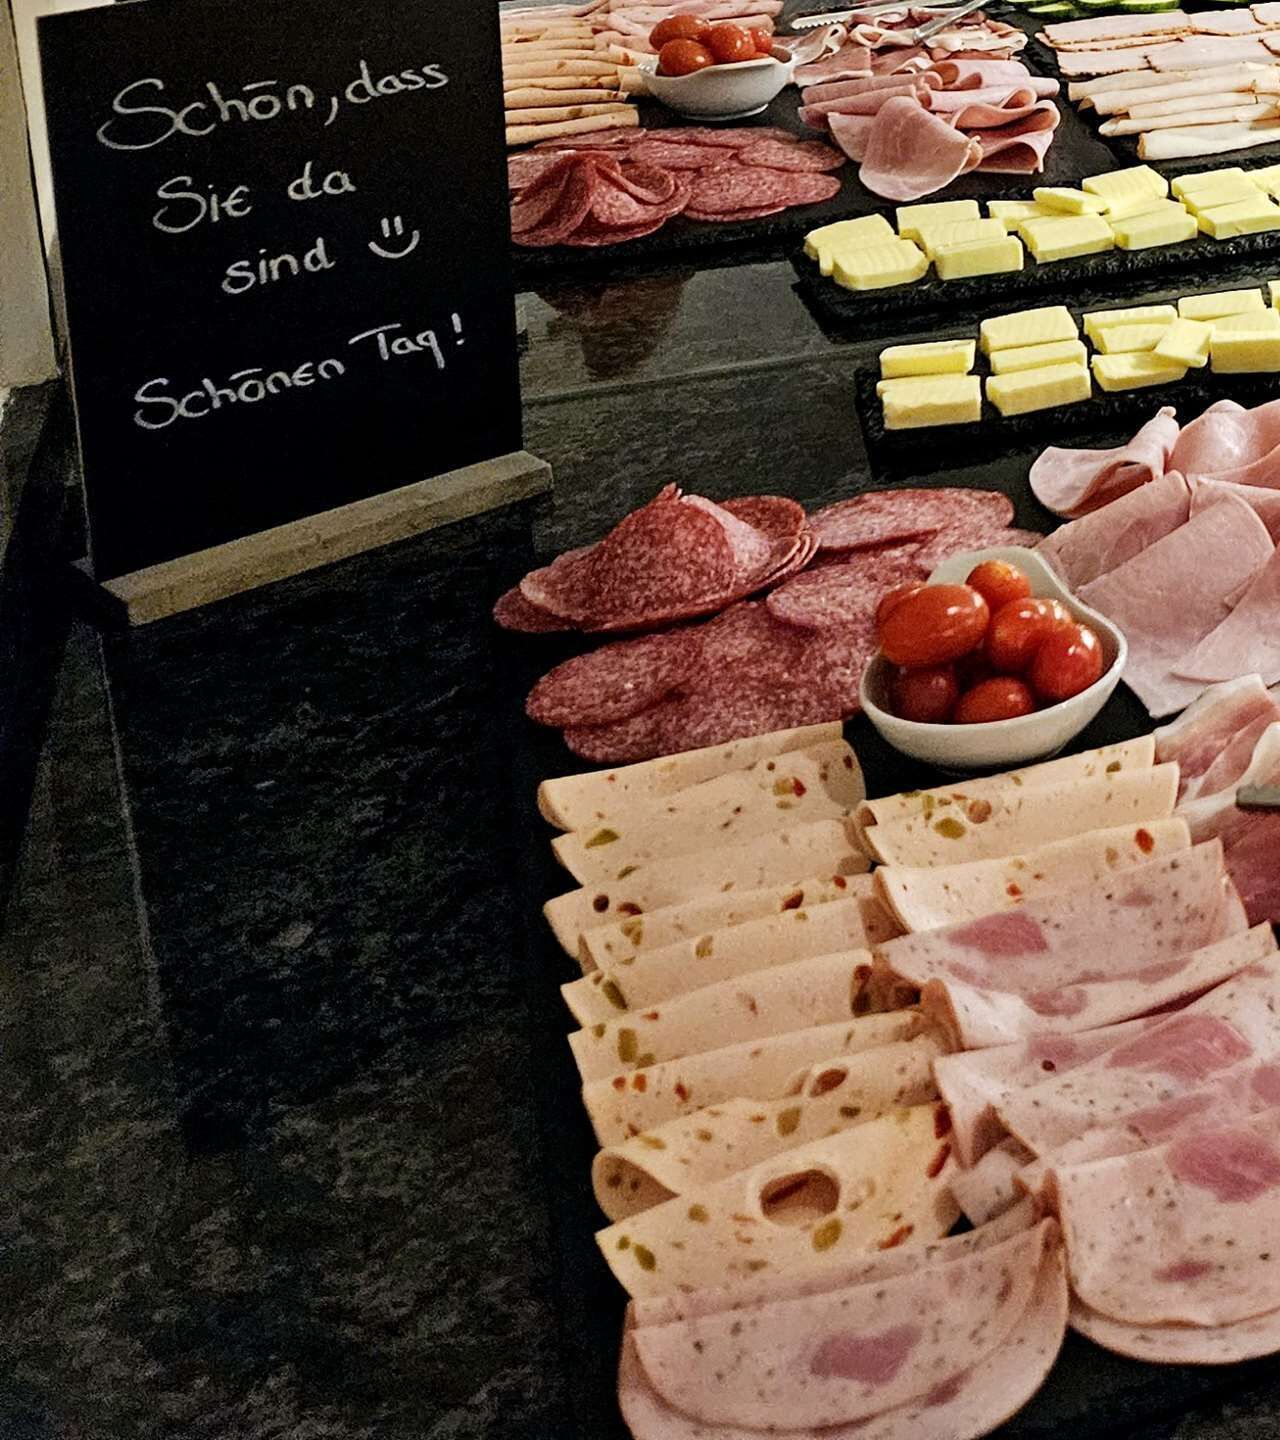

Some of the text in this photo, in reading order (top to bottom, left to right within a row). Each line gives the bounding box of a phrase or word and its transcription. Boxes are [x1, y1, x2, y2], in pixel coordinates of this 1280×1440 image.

[344, 61, 449, 105] dass
[152, 162, 357, 234] Sie da
[221, 238, 335, 295] sind
